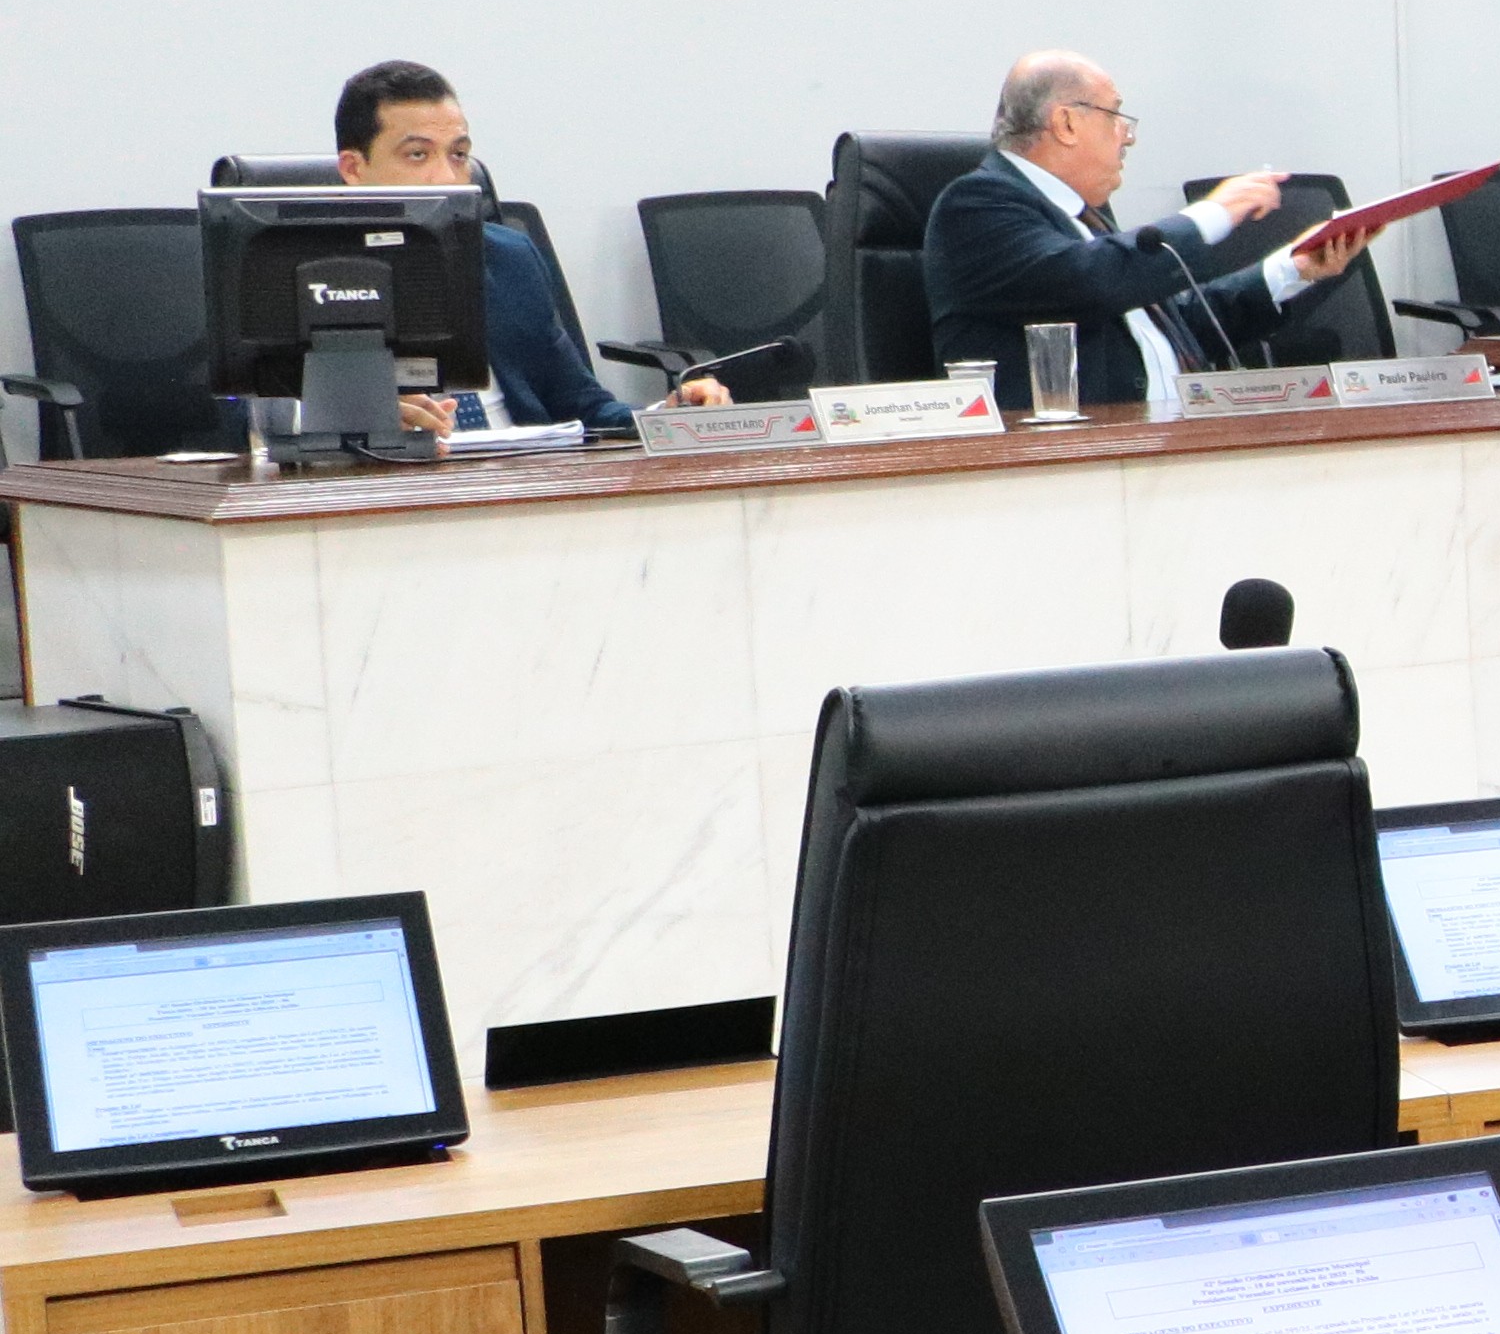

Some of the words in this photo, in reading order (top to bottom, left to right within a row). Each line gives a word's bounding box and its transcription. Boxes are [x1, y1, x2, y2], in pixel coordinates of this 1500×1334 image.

[327, 288, 380, 301] TANCA
[1378, 373, 1407, 384] Paulo
[864, 402, 912, 416] Jonathan
[913, 401, 951, 411] Santos
[234, 1135, 280, 1148] TANCA
